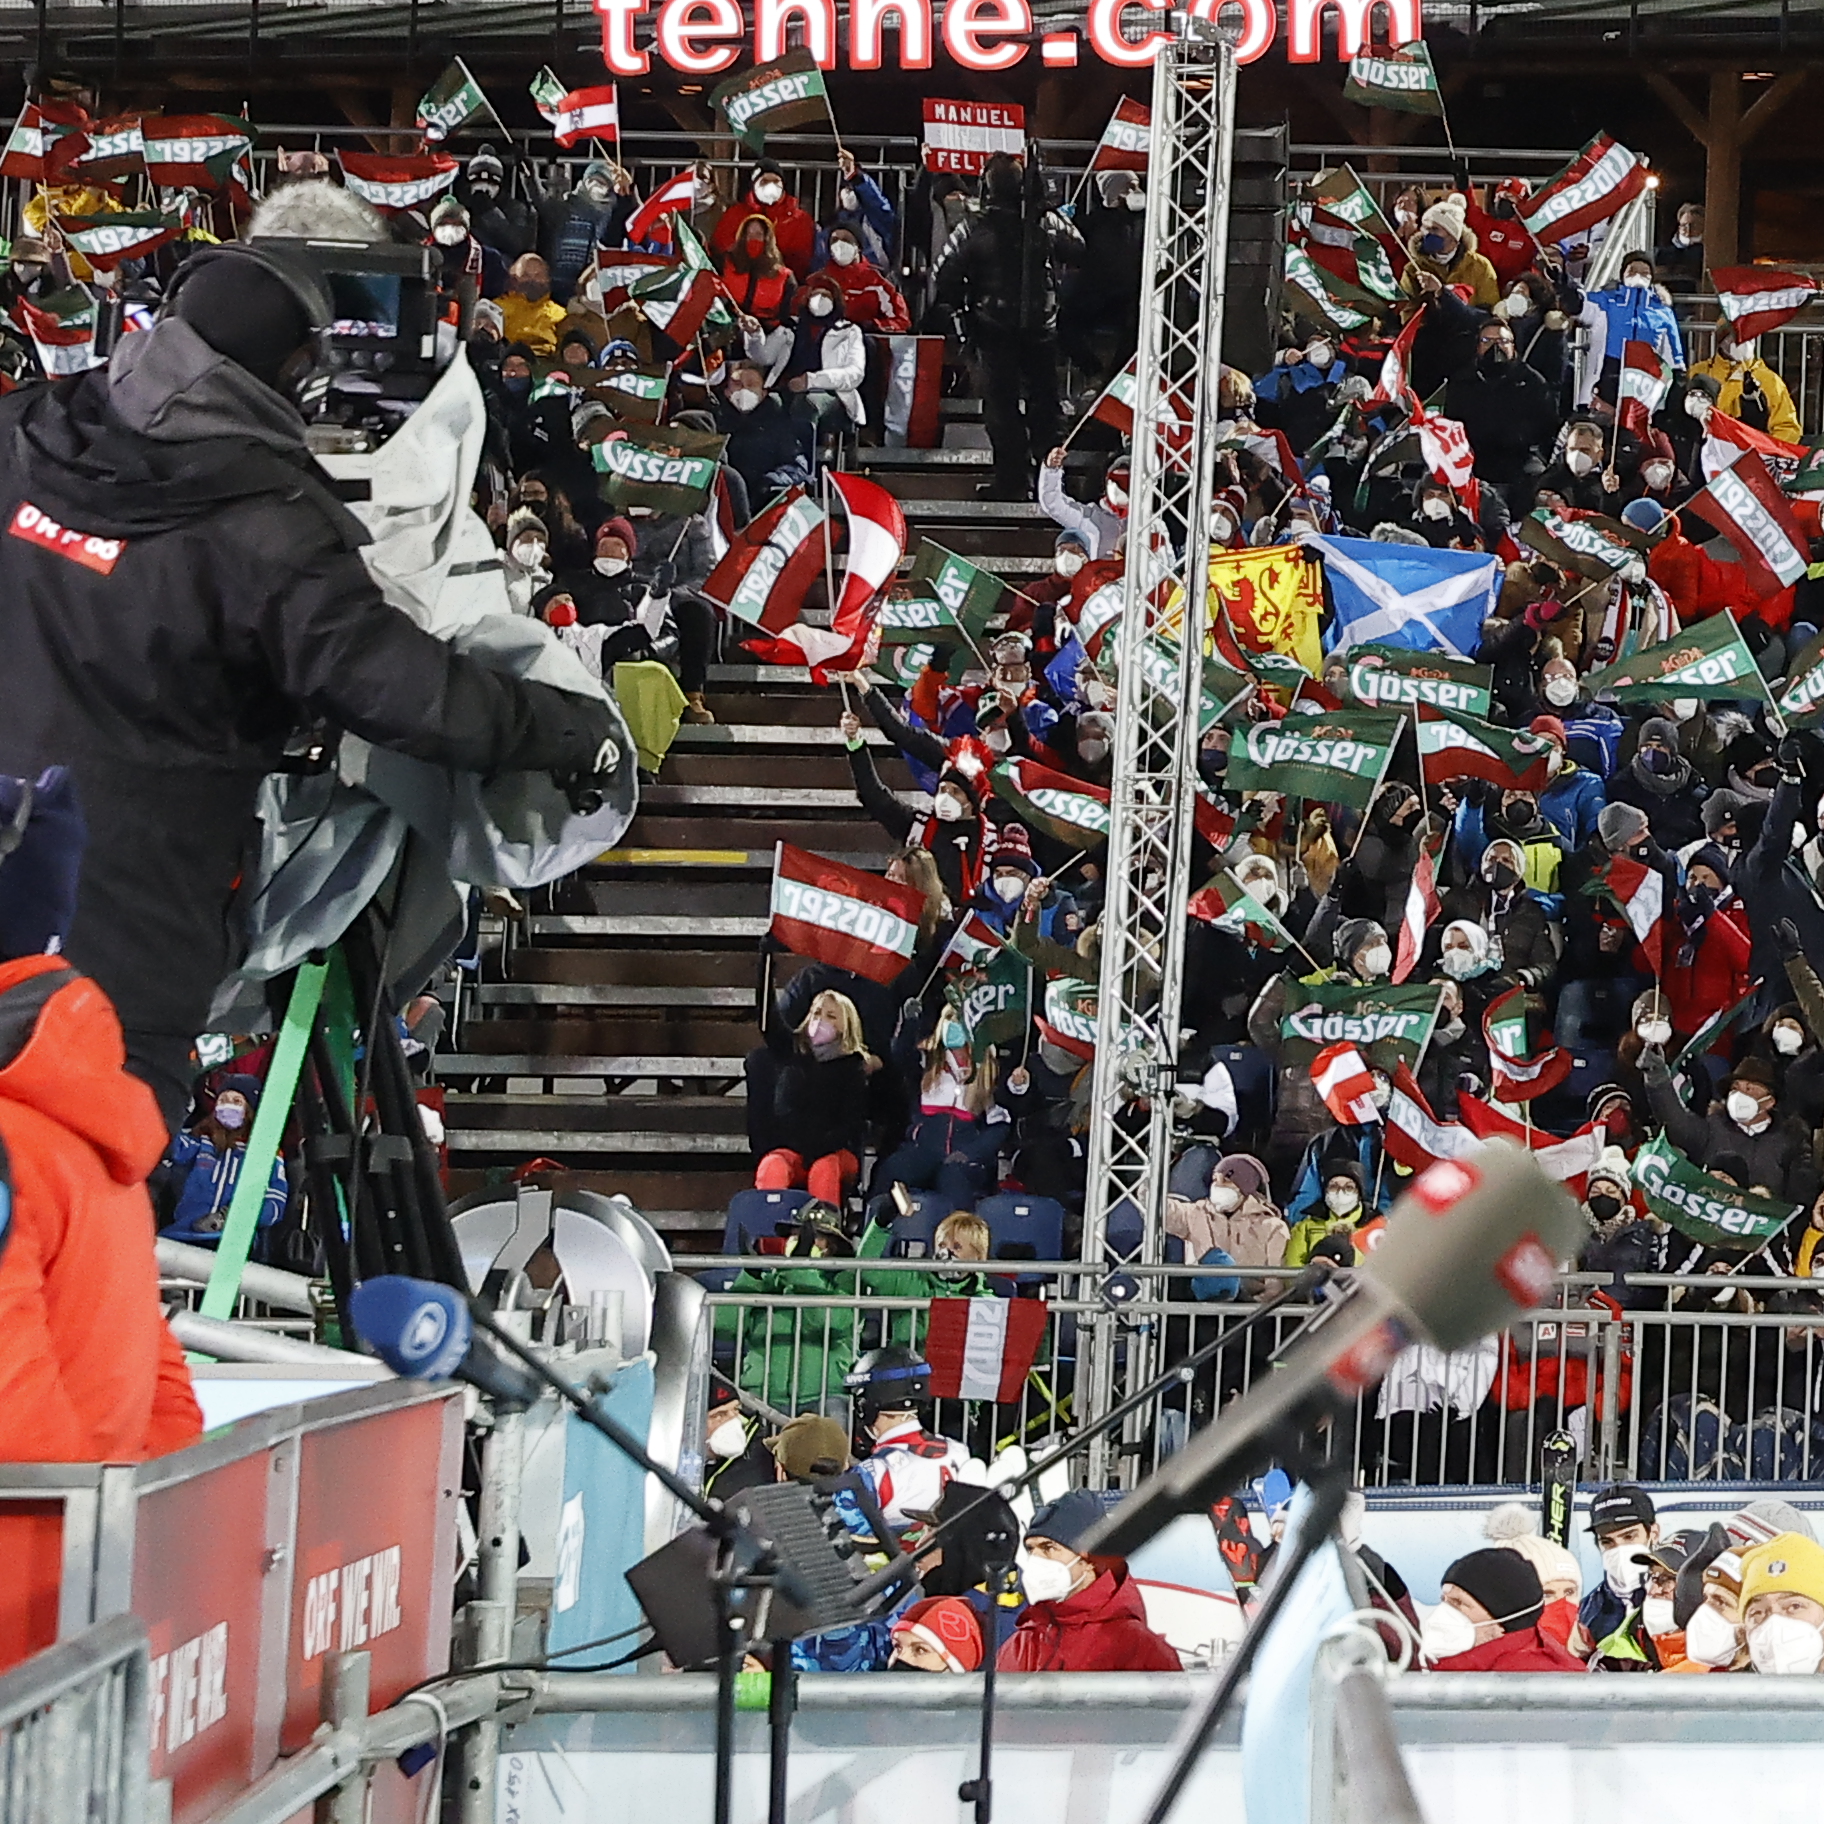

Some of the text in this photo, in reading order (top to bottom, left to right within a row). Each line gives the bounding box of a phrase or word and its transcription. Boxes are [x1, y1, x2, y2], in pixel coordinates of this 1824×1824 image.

[934, 104, 1014, 127] MANUEL
[1350, 655, 1476, 710] Gösser
[1247, 719, 1377, 773] Gösser
[1639, 1154, 1769, 1236] Gösser
